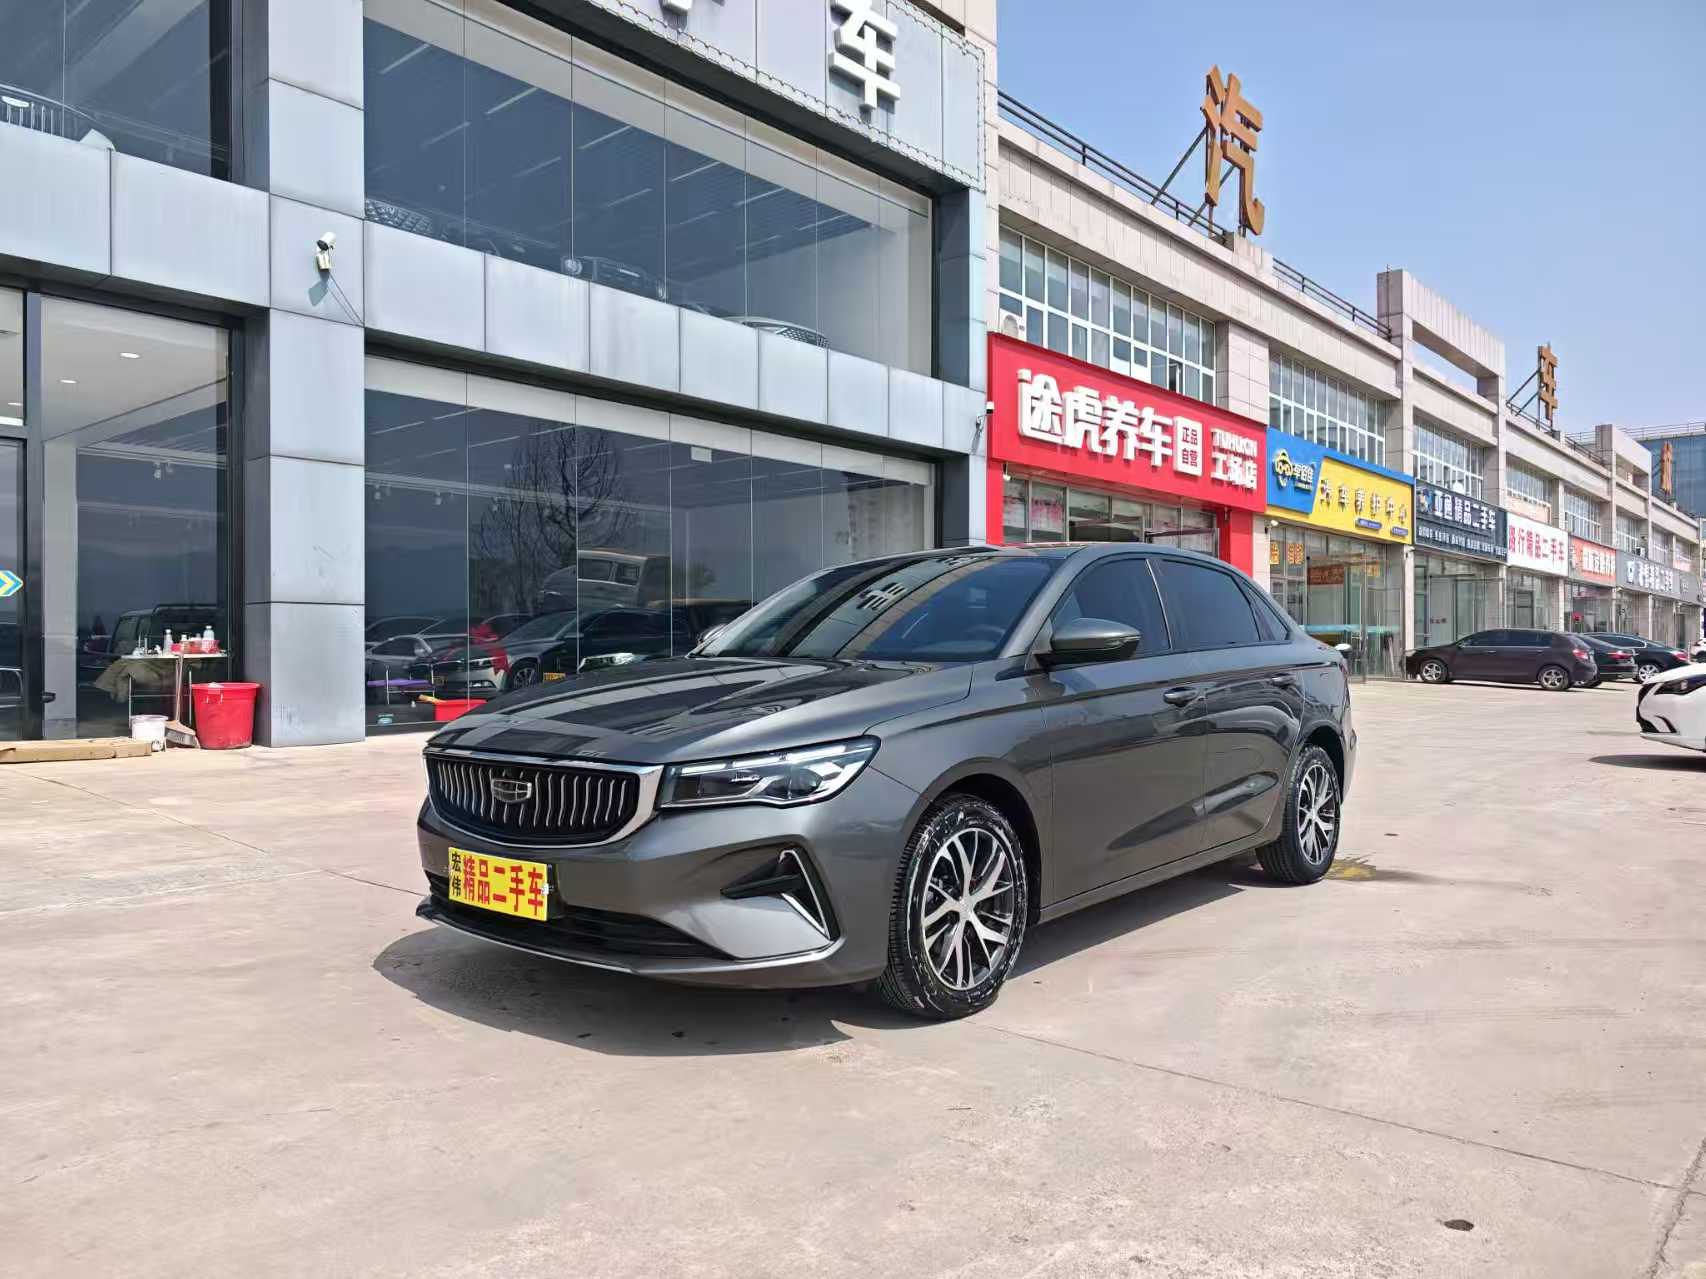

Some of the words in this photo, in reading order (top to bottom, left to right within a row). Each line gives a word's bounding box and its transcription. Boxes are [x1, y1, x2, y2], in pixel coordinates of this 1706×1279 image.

[1201, 65, 1264, 235] 汽
[1018, 369, 1173, 467] 途虎养车
[463, 855, 543, 915] 精品二手车
